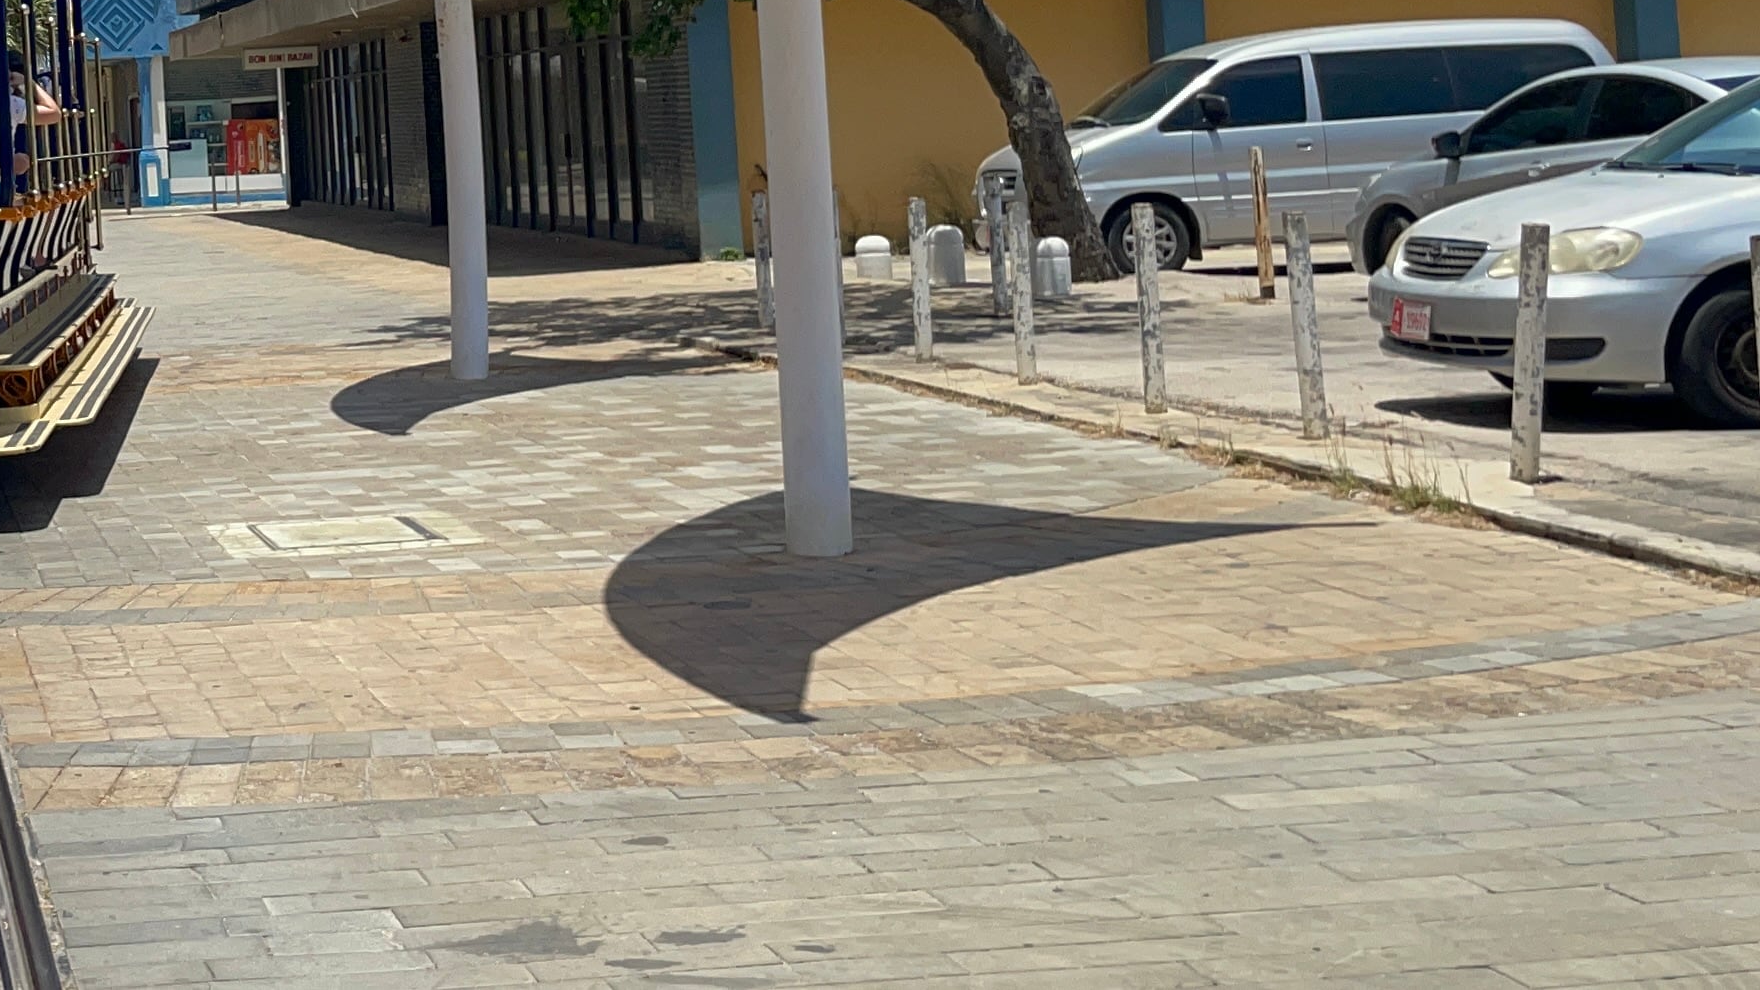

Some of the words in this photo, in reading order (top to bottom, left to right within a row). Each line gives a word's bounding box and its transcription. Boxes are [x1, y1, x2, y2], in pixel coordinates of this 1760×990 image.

[248, 54, 266, 63] BON
[269, 53, 286, 62] BINI
[287, 52, 313, 61] BAZAR
